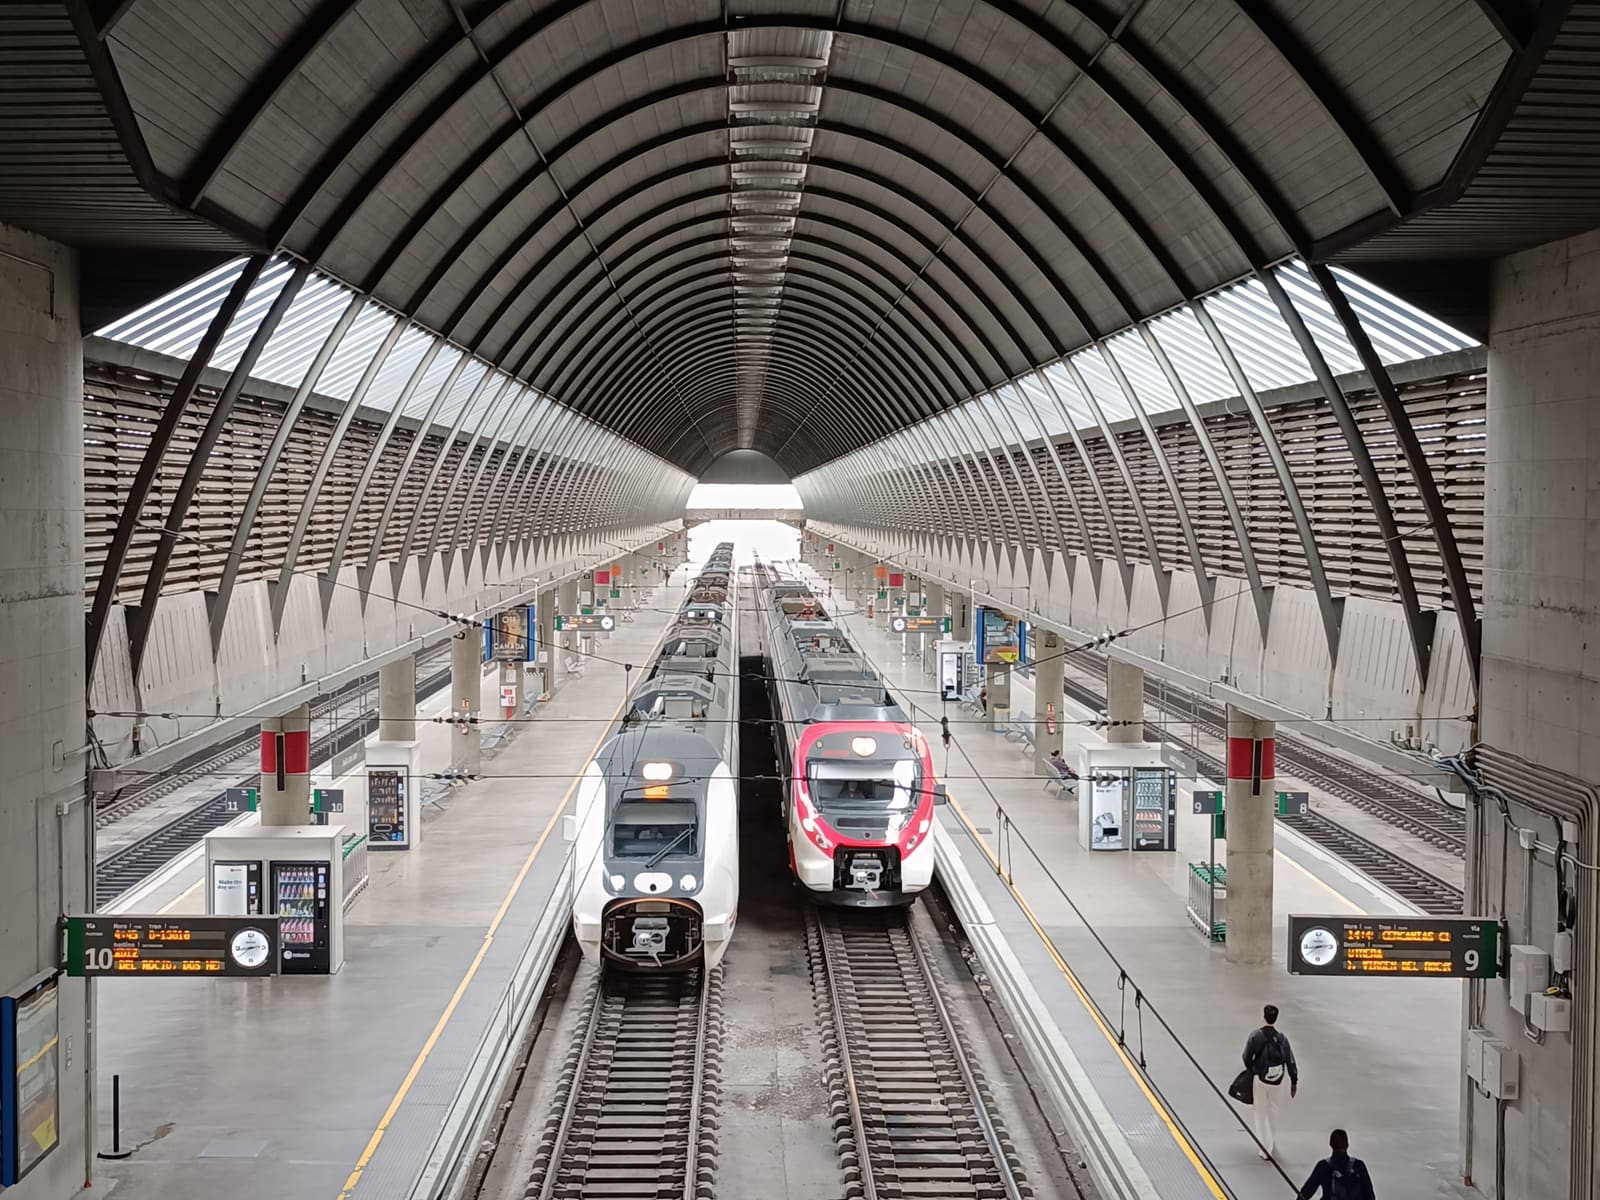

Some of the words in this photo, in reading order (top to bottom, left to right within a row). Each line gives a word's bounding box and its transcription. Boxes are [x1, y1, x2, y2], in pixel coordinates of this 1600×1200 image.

[228, 802, 238, 810] 11
[332, 803, 342, 812] 10
[1194, 802, 1202, 813] 9
[1300, 803, 1307, 814] 8
[85, 948, 113, 970] 10
[1464, 949, 1479, 971] 9
